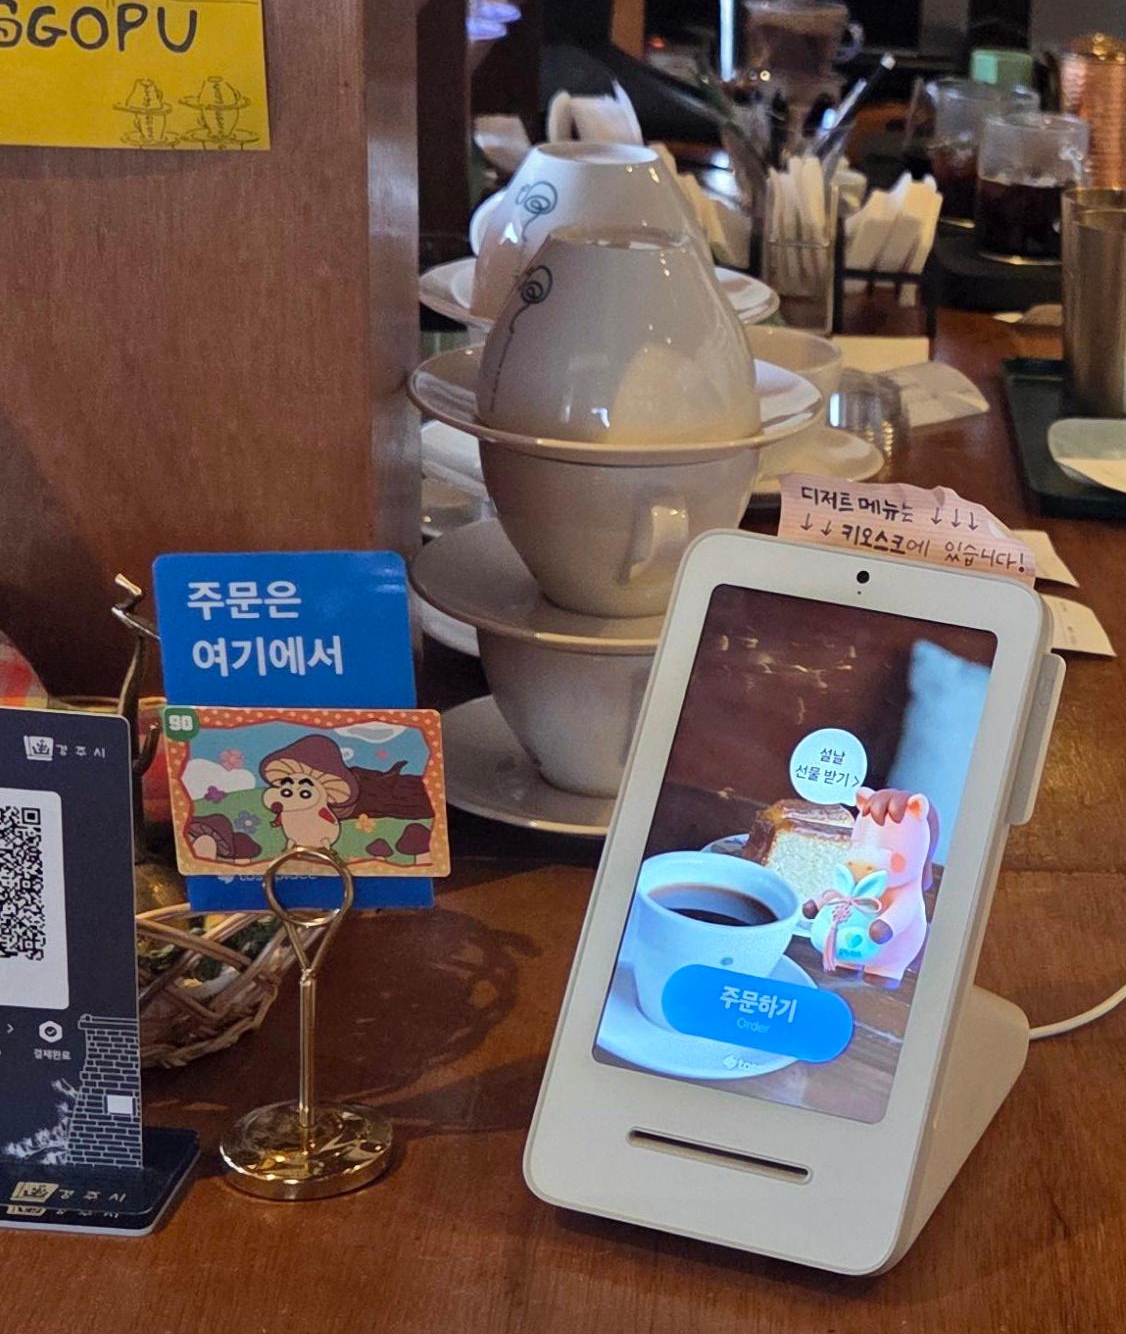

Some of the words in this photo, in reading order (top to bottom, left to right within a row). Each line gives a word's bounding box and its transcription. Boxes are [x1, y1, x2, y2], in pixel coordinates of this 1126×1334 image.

[801, 486, 854, 512] 디저트
[858, 498, 914, 523] 메뉴는
[841, 523, 930, 557] 키오스크에
[945, 540, 1025, 573] 있습니다!
[187, 580, 301, 620] 주문은
[192, 635, 344, 677] 여기에서
[820, 748, 846, 765] 설날
[795, 765, 821, 782] 선물
[824, 769, 850, 787] 받기
[720, 985, 798, 1024] 주문하기
[736, 1017, 770, 1035] Order
